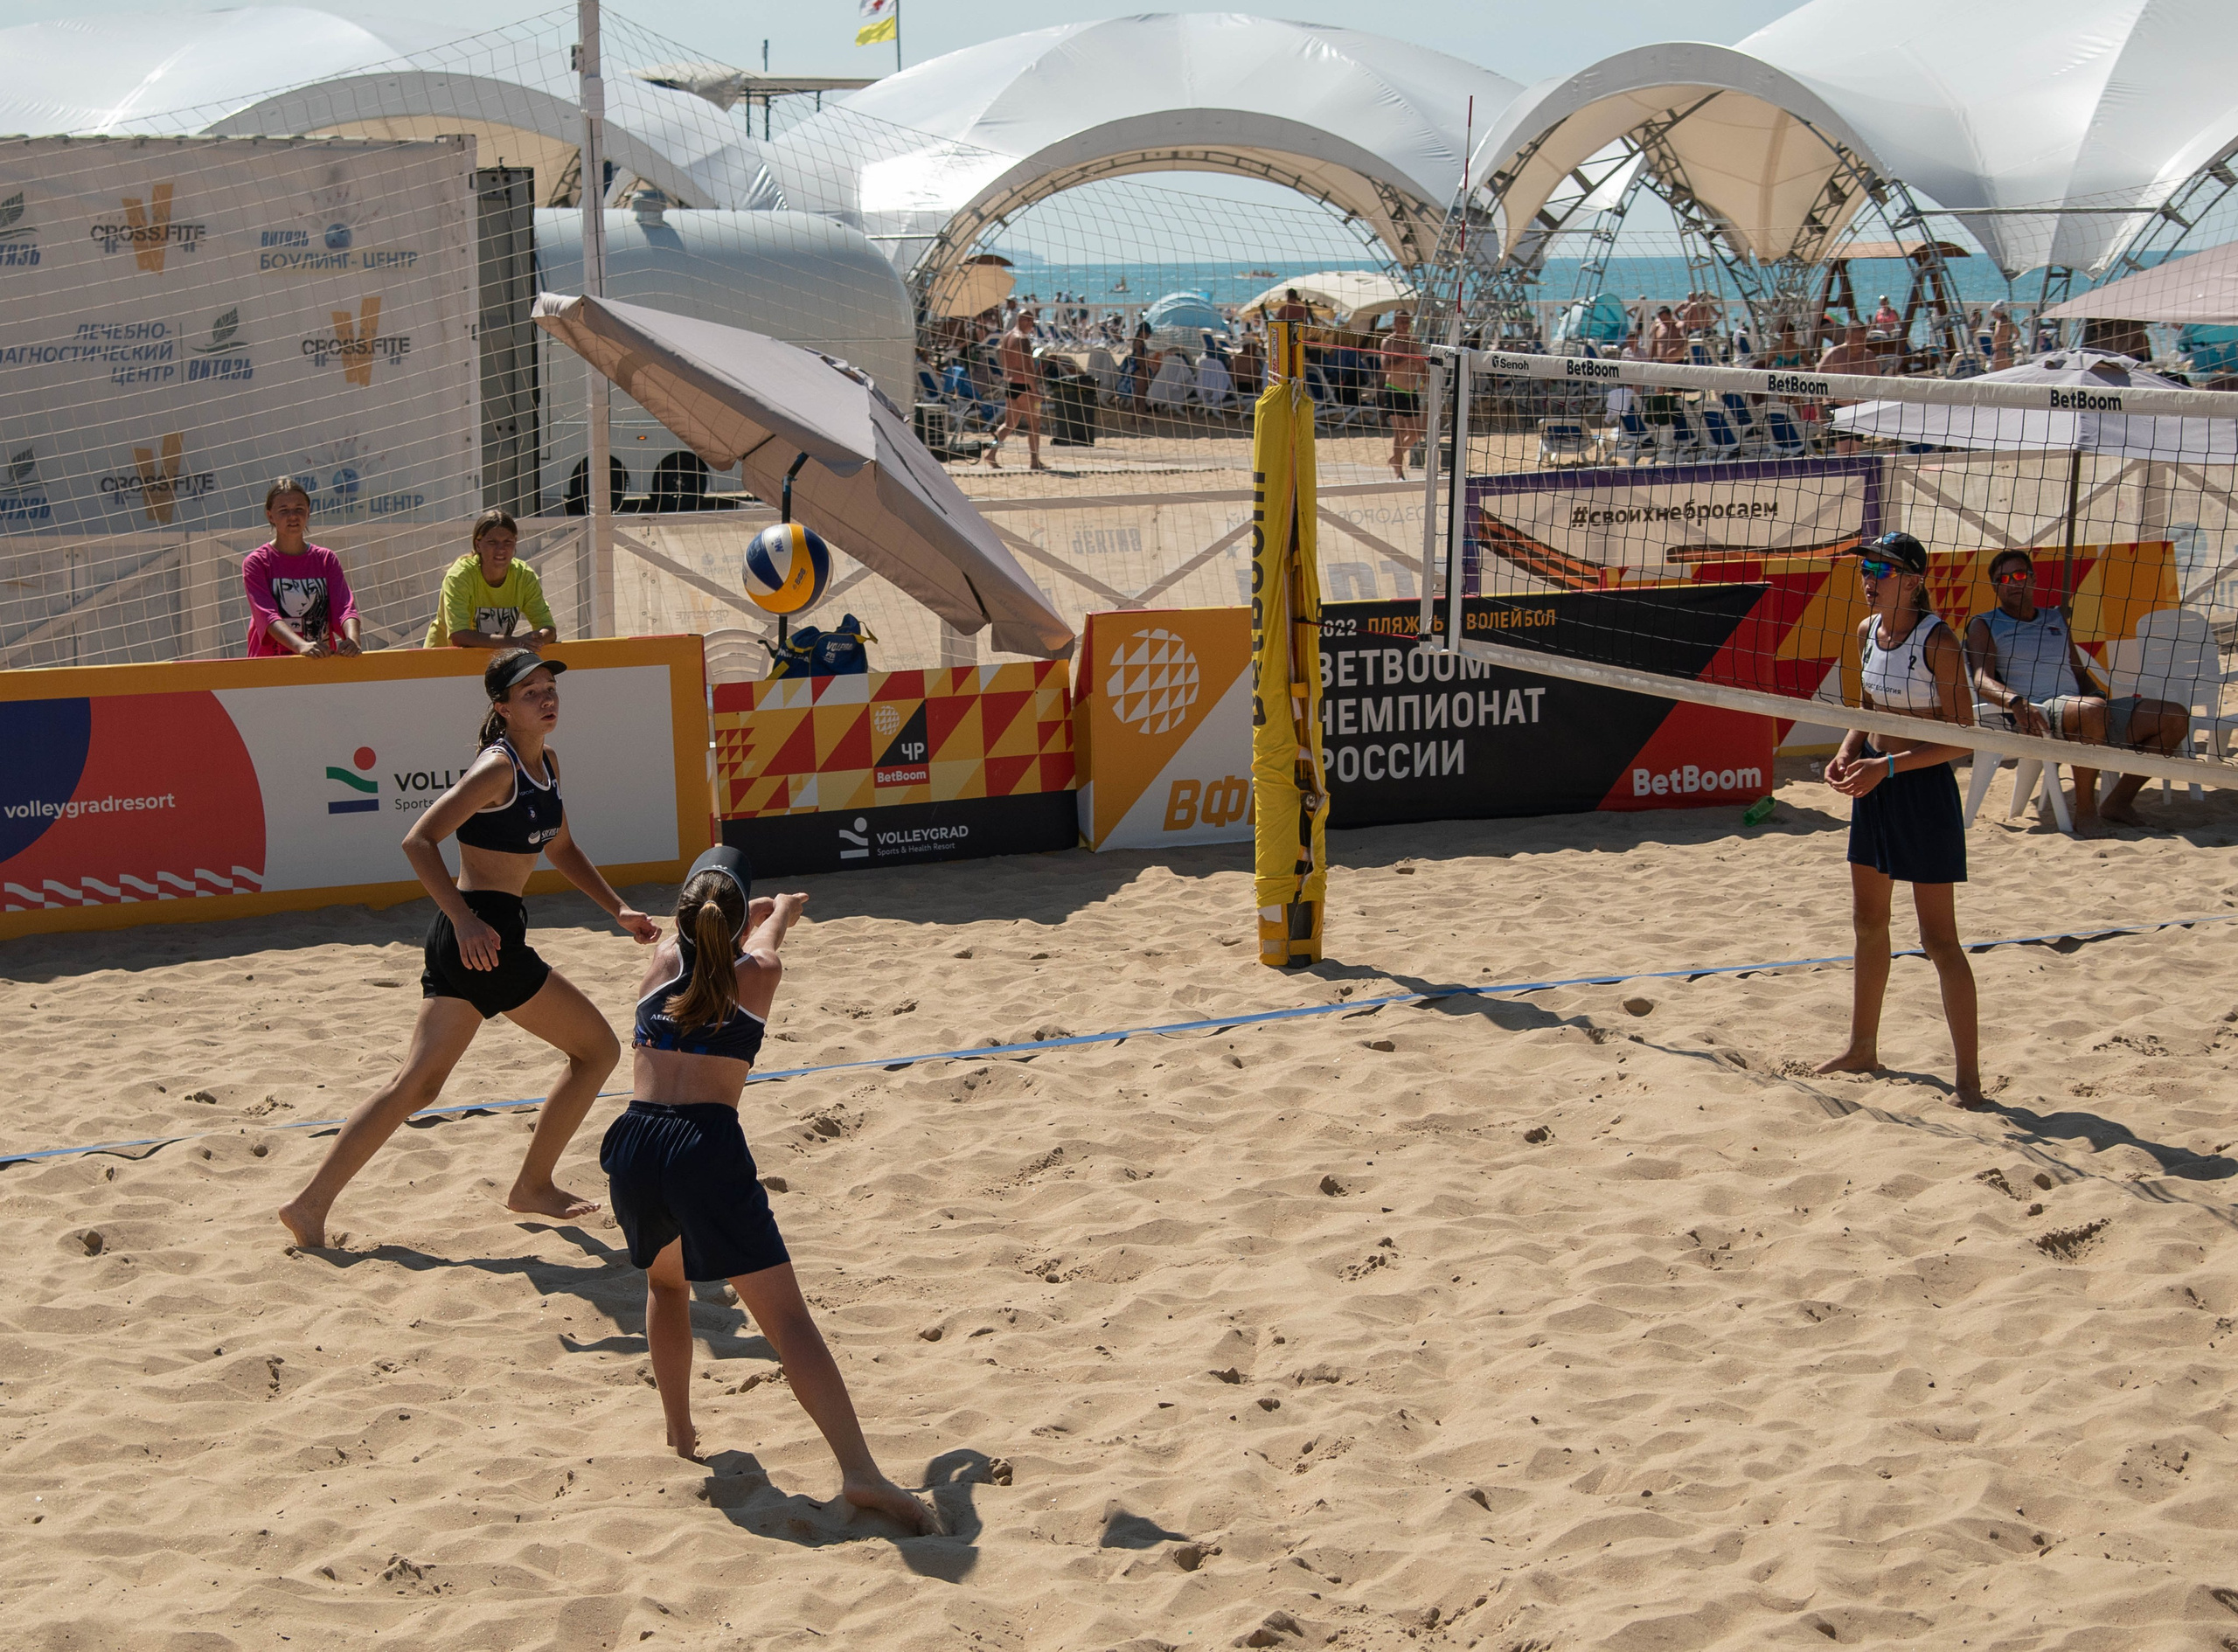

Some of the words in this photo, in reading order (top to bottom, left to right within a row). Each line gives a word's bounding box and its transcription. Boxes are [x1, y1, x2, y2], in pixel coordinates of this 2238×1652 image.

[261, 230, 309, 247] ВИТЯЗЬ
[363, 252, 418, 270] ЦЕНТР
[73, 322, 172, 340] ЛЕЧЕБНО-
[0, 340, 173, 364] АГНОСТИЧЕСКИЙ
[188, 359, 254, 381] ВИТЯЗЬ
[1499, 357, 1529, 371] Senoh
[1567, 359, 1619, 378] BetBoom
[111, 366, 174, 385] ЦЕНТР
[1768, 374, 1828, 396] BetBoom
[2050, 389, 2122, 411] BetBoom
[370, 495, 424, 513] ЦЕНТР
[1572, 498, 1779, 528] #своихнебросаем
[1466, 607, 1556, 631] ВОЛЕЙБОЛ
[901, 742, 925, 761] ЧР
[877, 770, 927, 783] BetBoom
[1633, 764, 1762, 796] BetBoom
[3, 793, 176, 820] volleygradresort
[877, 826, 969, 845] VOLLEYGRAD
[877, 847, 900, 857] Sports
[908, 843, 932, 853] Health
[933, 842, 956, 851] Resort
